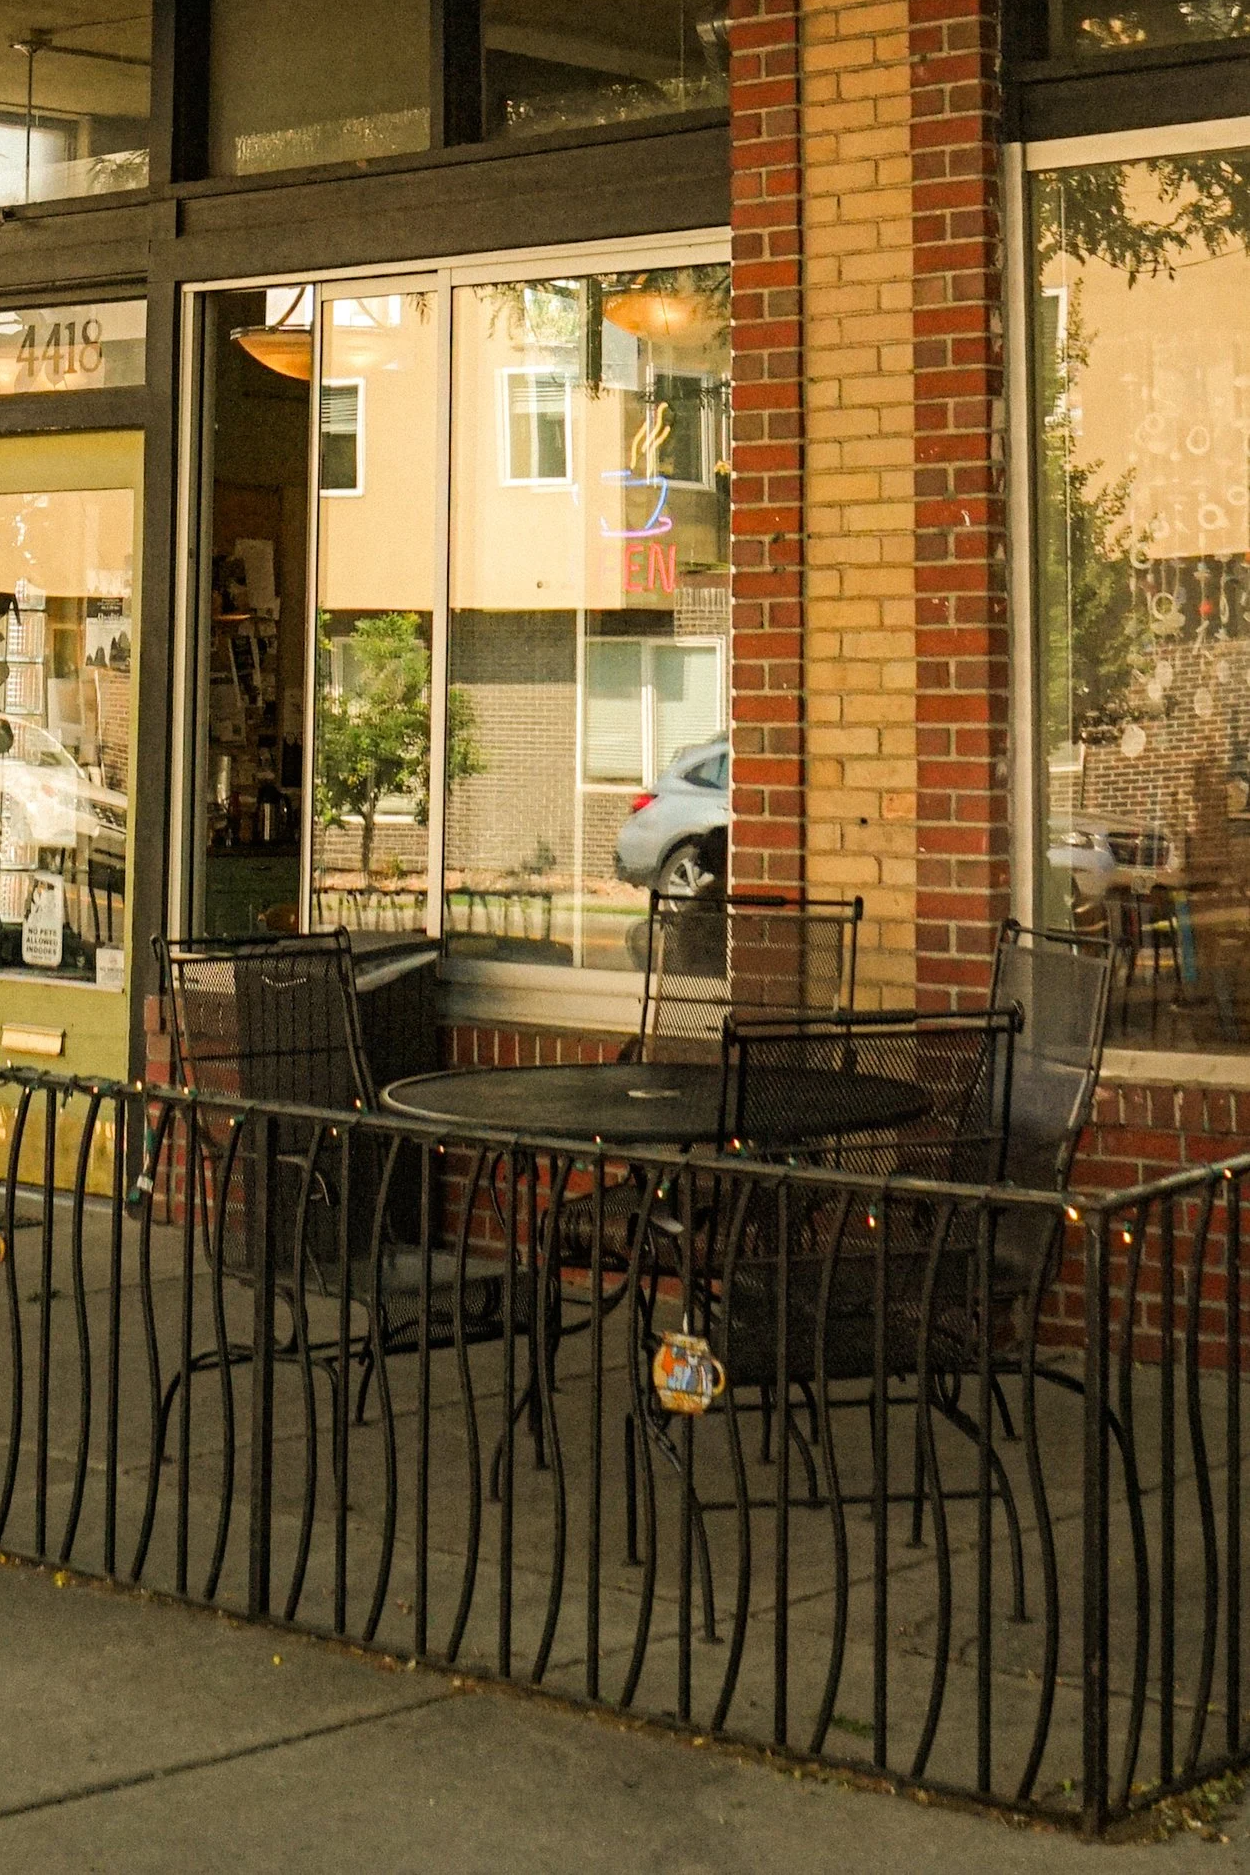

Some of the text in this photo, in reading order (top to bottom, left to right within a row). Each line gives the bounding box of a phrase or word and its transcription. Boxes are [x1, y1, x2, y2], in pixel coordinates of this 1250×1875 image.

[16, 318, 103, 378] 4418
[28, 927, 57, 937] NO PETS
[26, 936, 58, 946] ALLOWED
[26, 945, 57, 956] INDOORS
